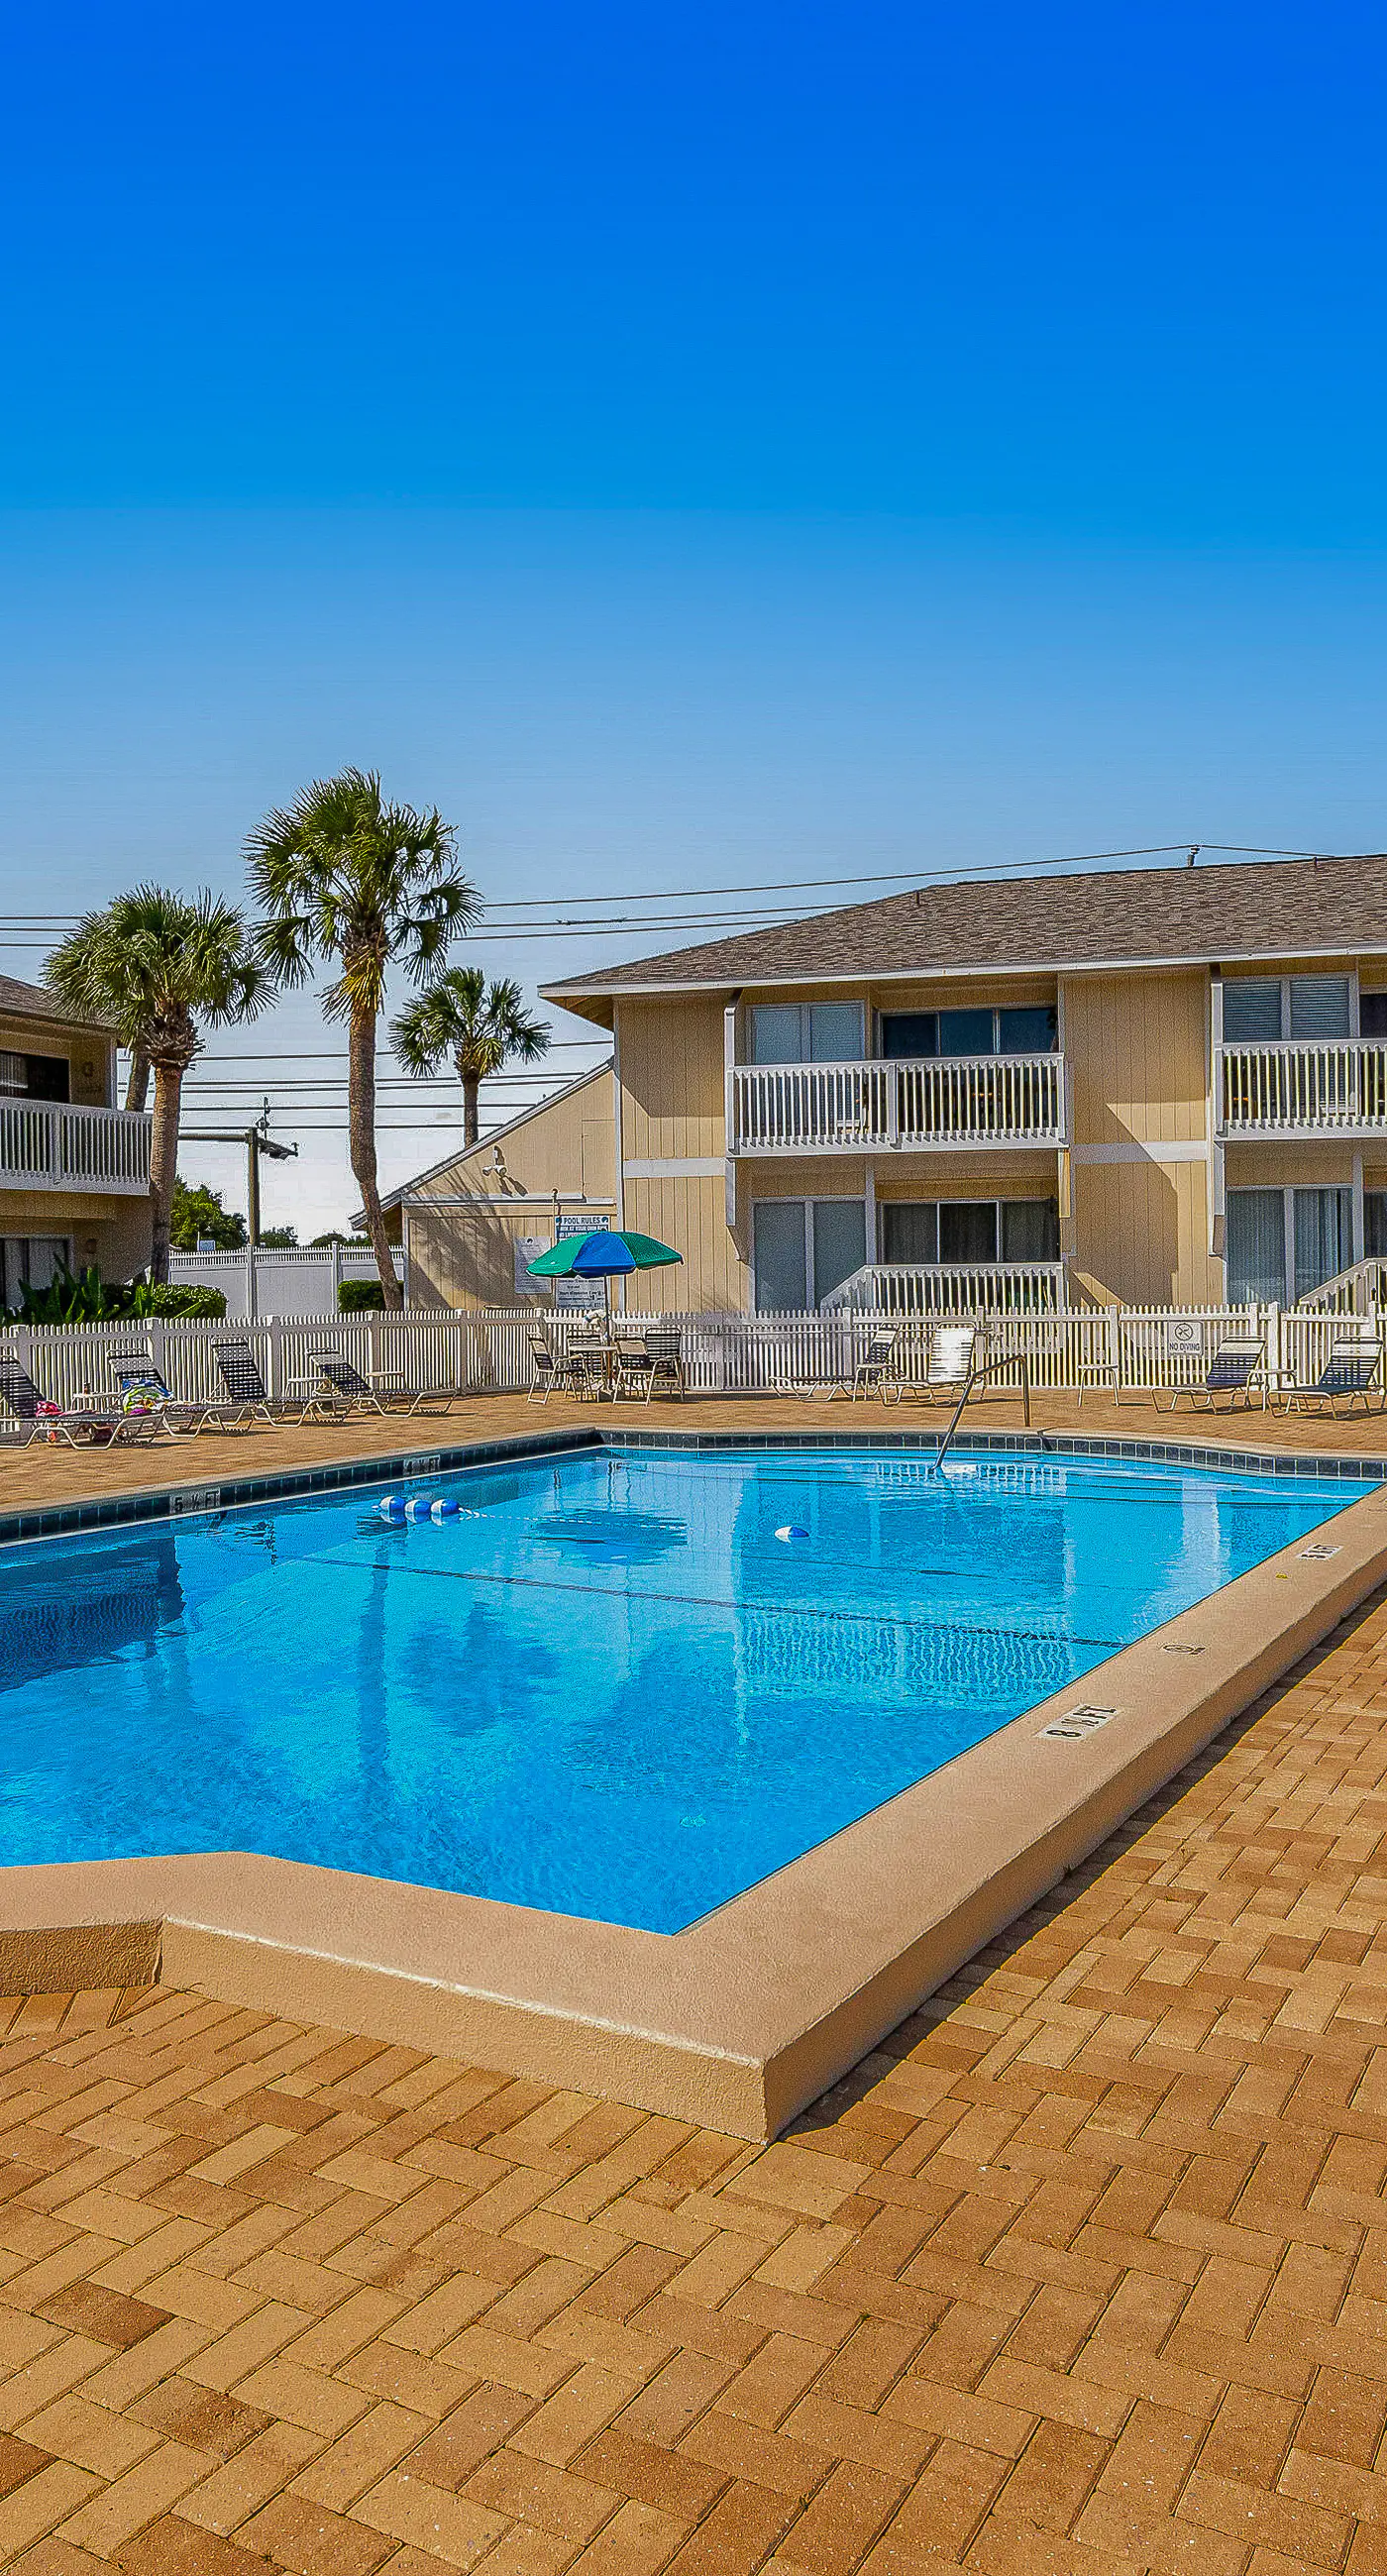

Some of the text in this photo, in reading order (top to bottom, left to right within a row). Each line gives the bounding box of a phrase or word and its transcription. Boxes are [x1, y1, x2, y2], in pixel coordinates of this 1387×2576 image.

[1169, 1342, 1200, 1351] NO DIVING
[174, 1496, 183, 1512] 5
[205, 1489, 219, 1508] FT
[1045, 1729, 1083, 1738] 8
[1073, 1704, 1117, 1719] FT
